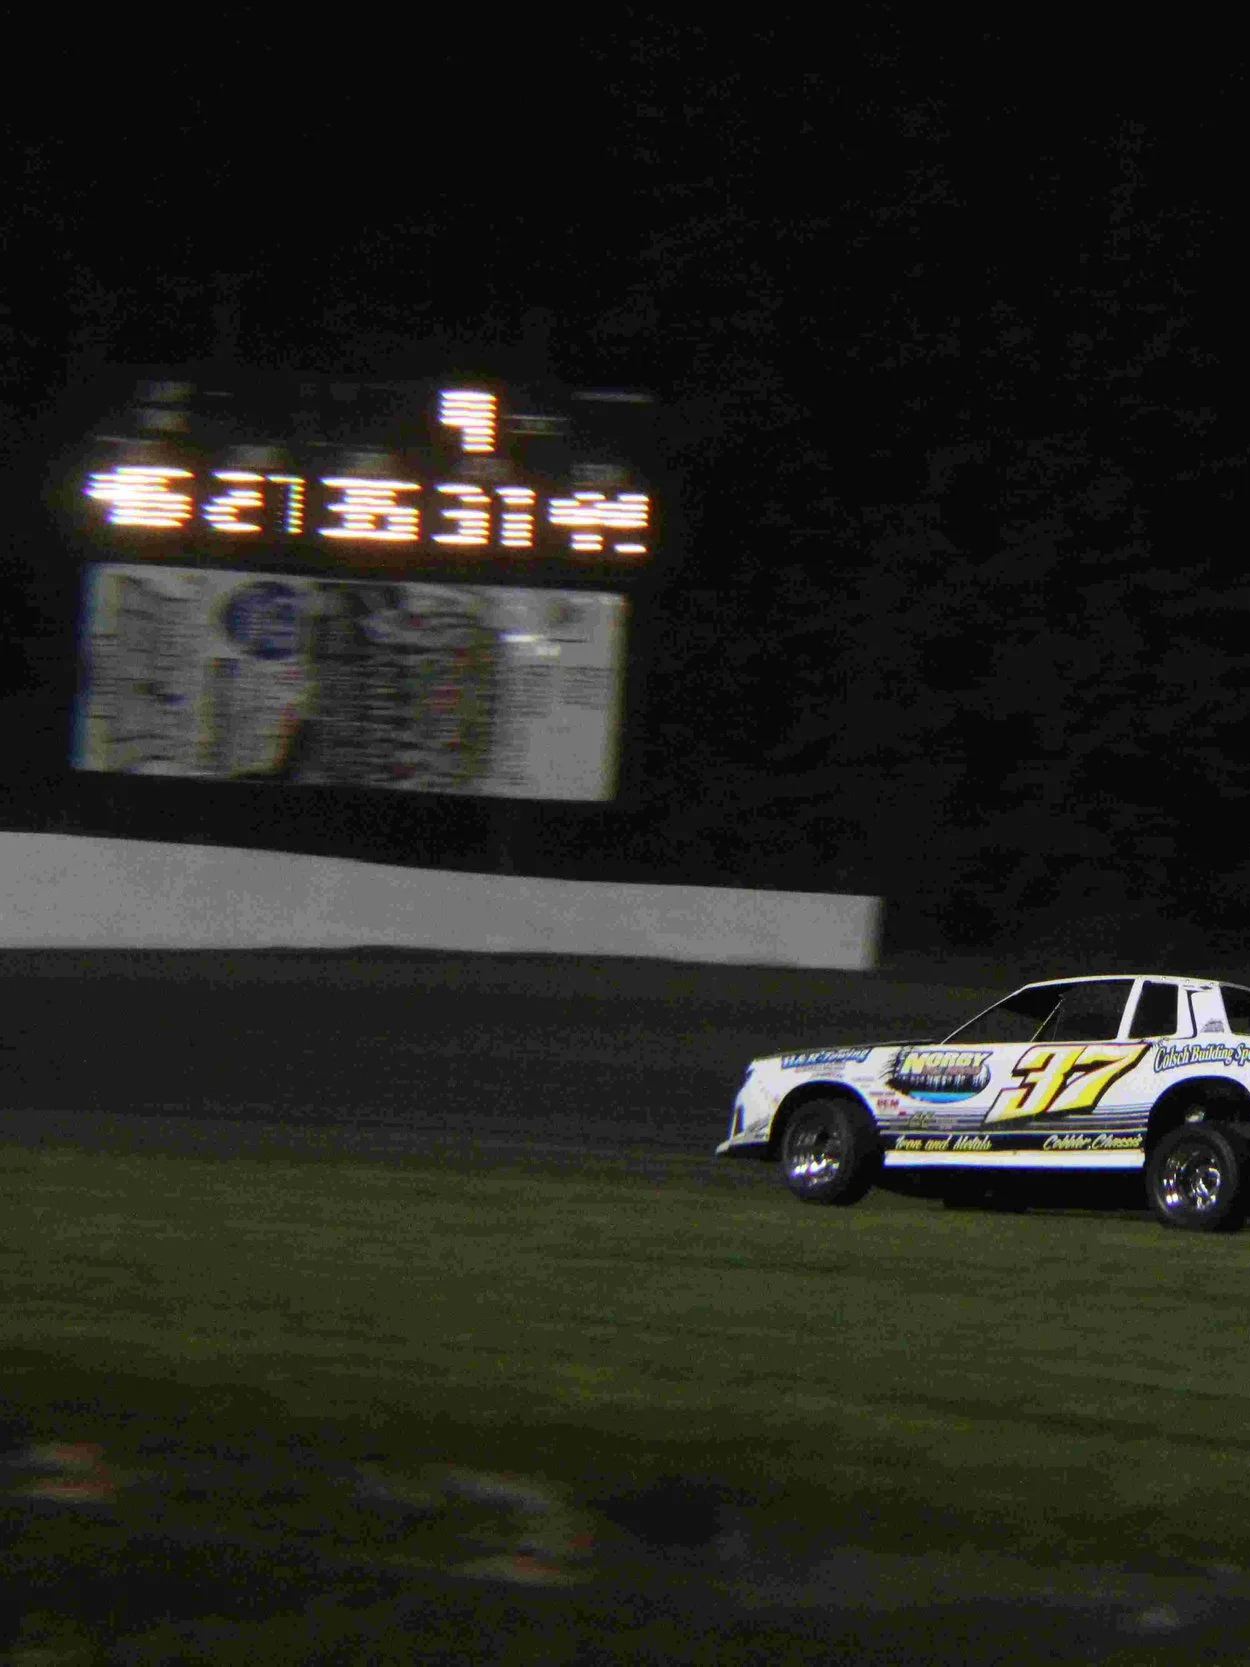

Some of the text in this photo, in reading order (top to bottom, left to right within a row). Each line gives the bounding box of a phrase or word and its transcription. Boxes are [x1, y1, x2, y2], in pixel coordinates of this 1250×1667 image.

[1153, 1043, 1191, 1073] Colsch
[1190, 1042, 1234, 1066] Building
[981, 1044, 1151, 1130] 37
[924, 1134, 952, 1150] and
